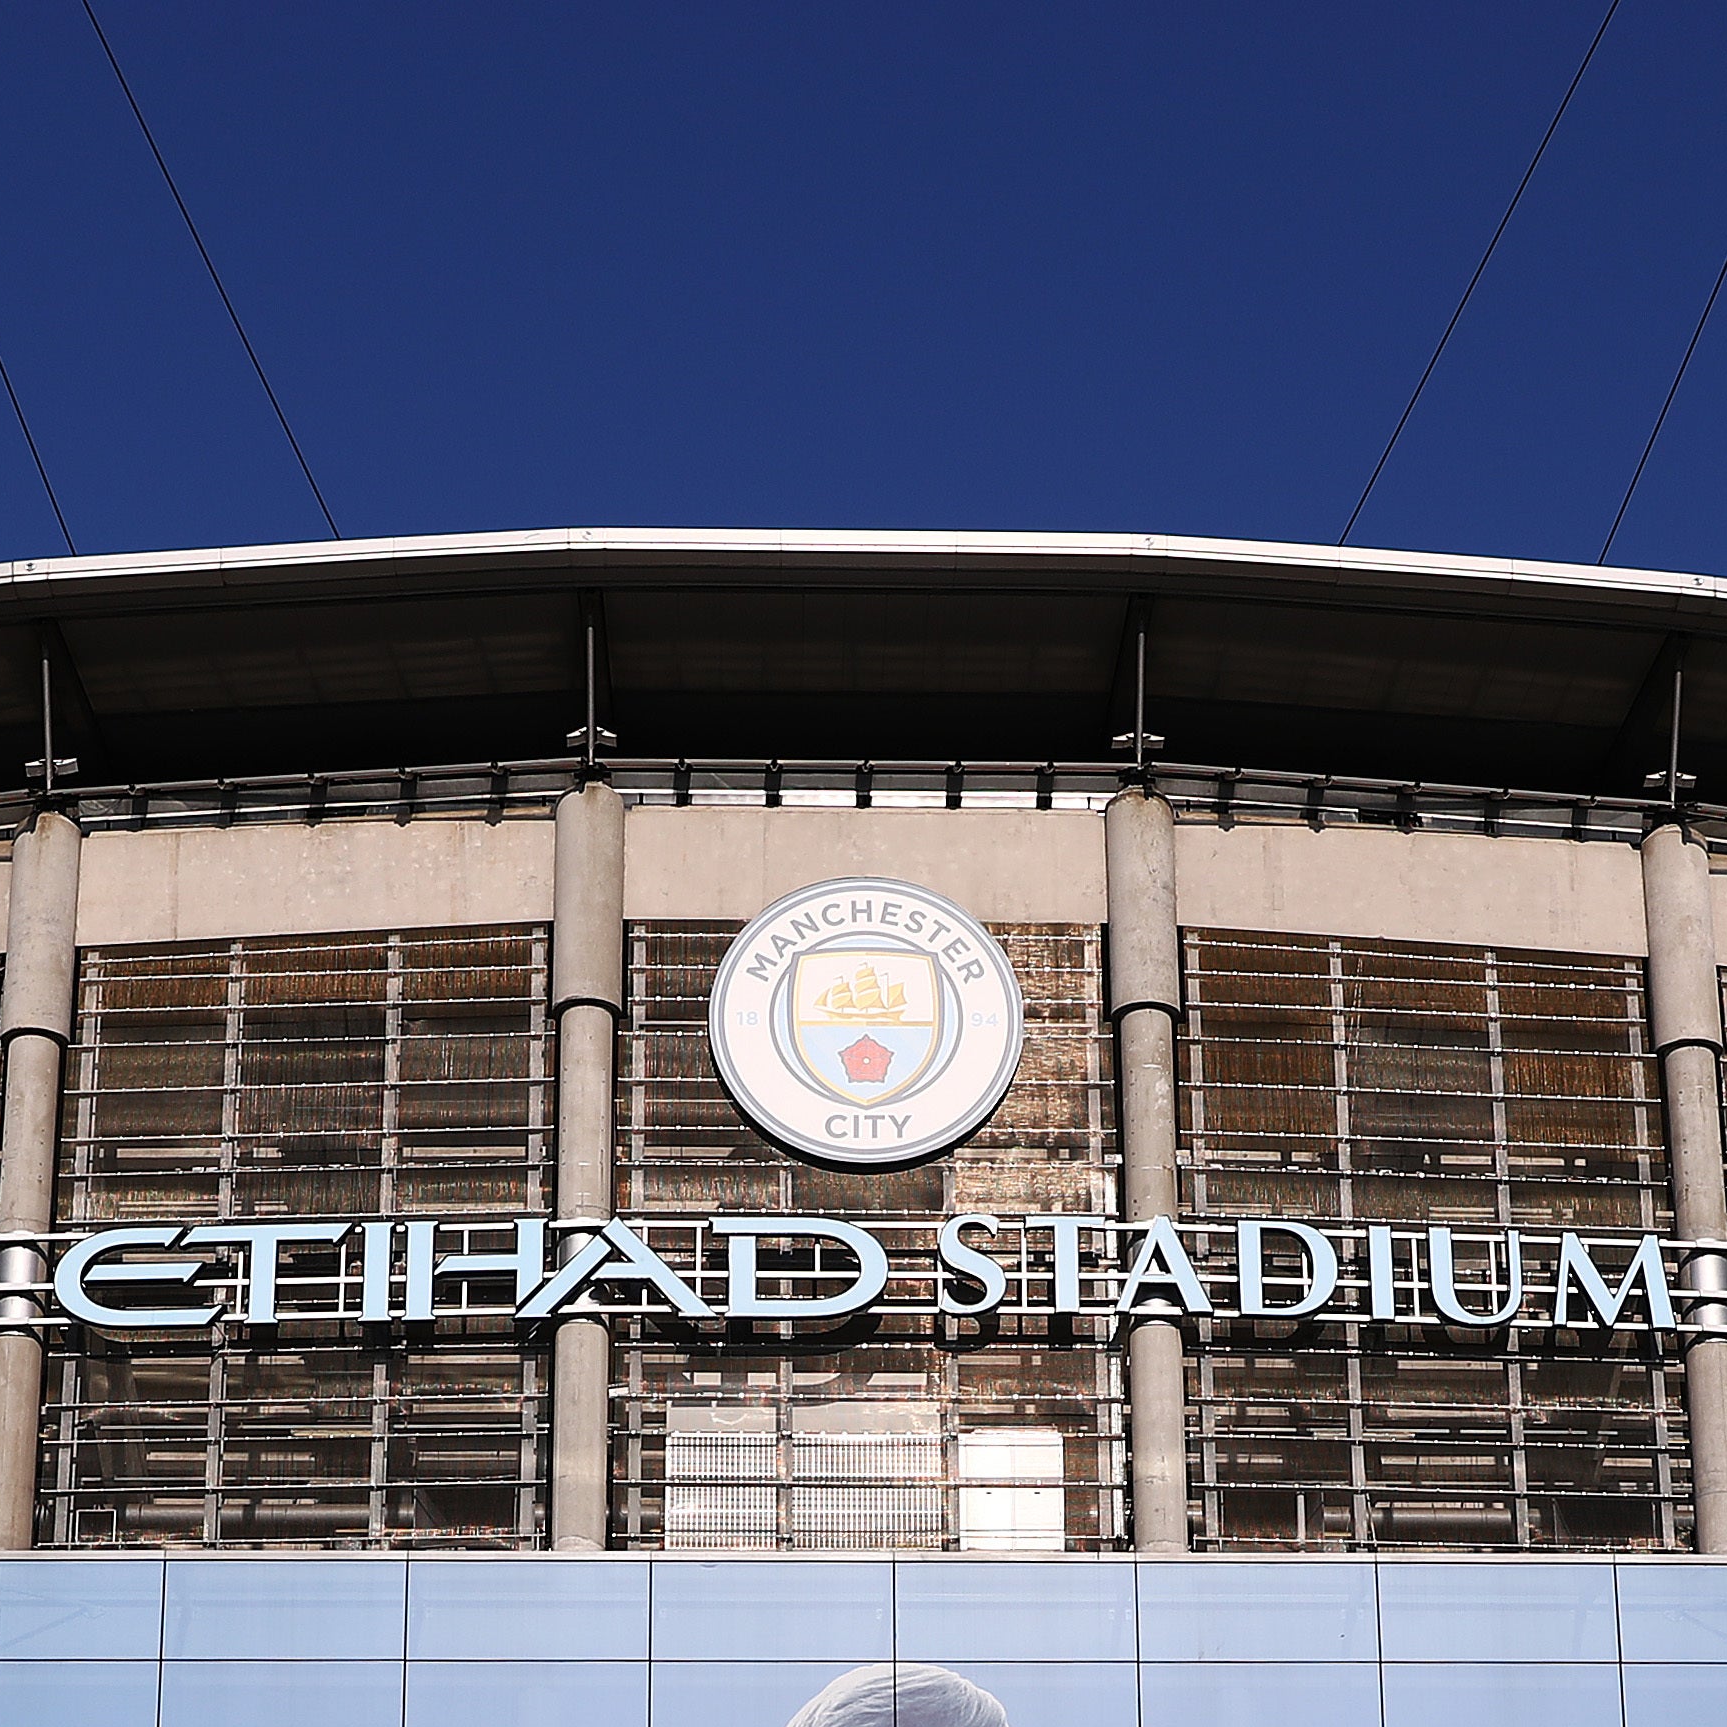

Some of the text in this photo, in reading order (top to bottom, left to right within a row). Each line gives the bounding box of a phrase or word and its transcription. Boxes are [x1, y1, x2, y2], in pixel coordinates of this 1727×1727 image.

[745, 900, 985, 984] MANCHESTER
[737, 1011, 998, 1027] 18 94
[825, 1114, 912, 1139] CITY
[54, 1216, 1679, 1330] ETIHAD STADIUM
